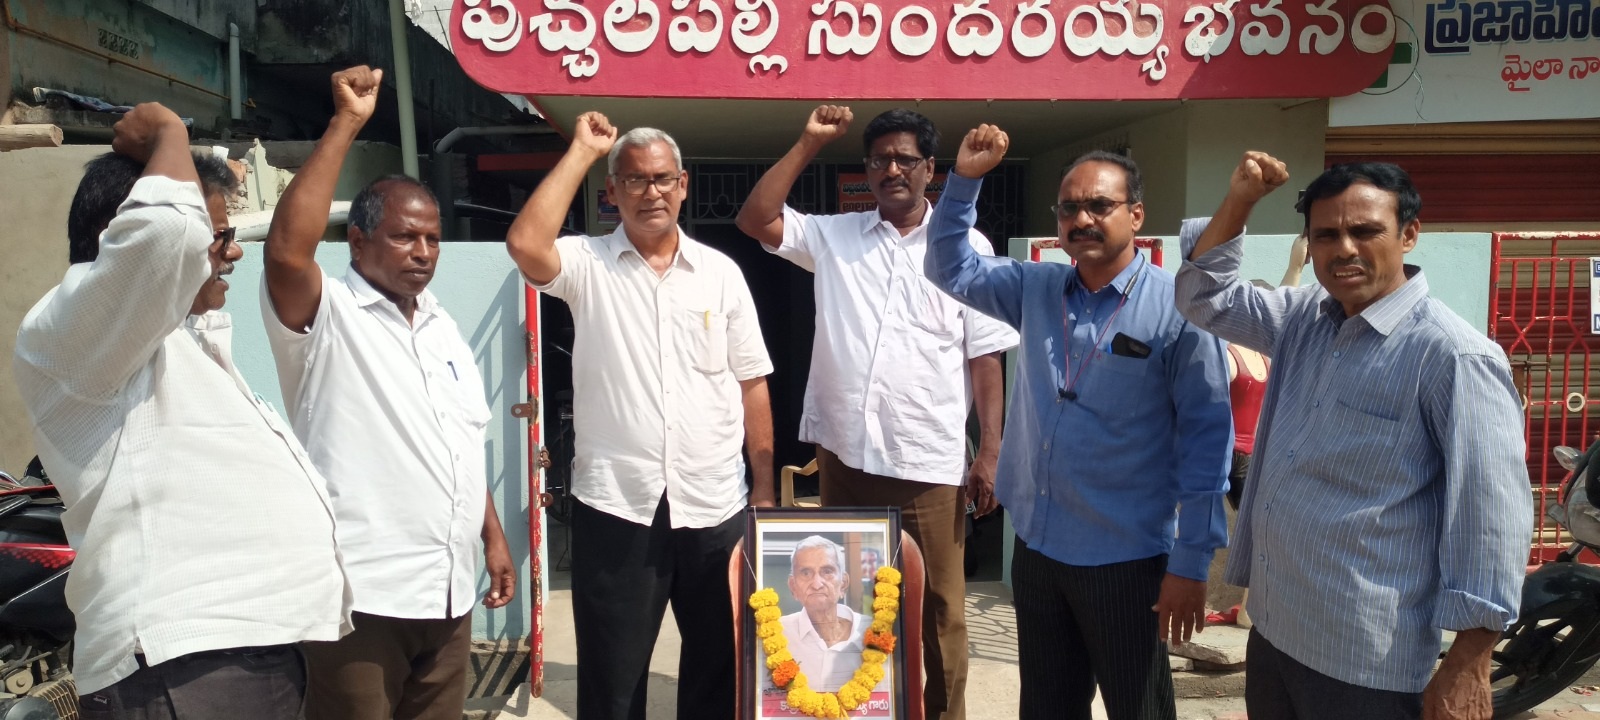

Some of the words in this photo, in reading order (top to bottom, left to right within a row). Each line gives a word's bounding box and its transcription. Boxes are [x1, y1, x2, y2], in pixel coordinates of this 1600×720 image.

[461, 0, 788, 78] పుచ్చలపల్లి
[807, 0, 1169, 81] సుందరయ్య
[1184, 0, 1397, 63] భవనం
[1425, 0, 1600, 54] ప్రజాహి
[1501, 54, 1563, 91] మైలా
[868, 699, 889, 710] గారు
